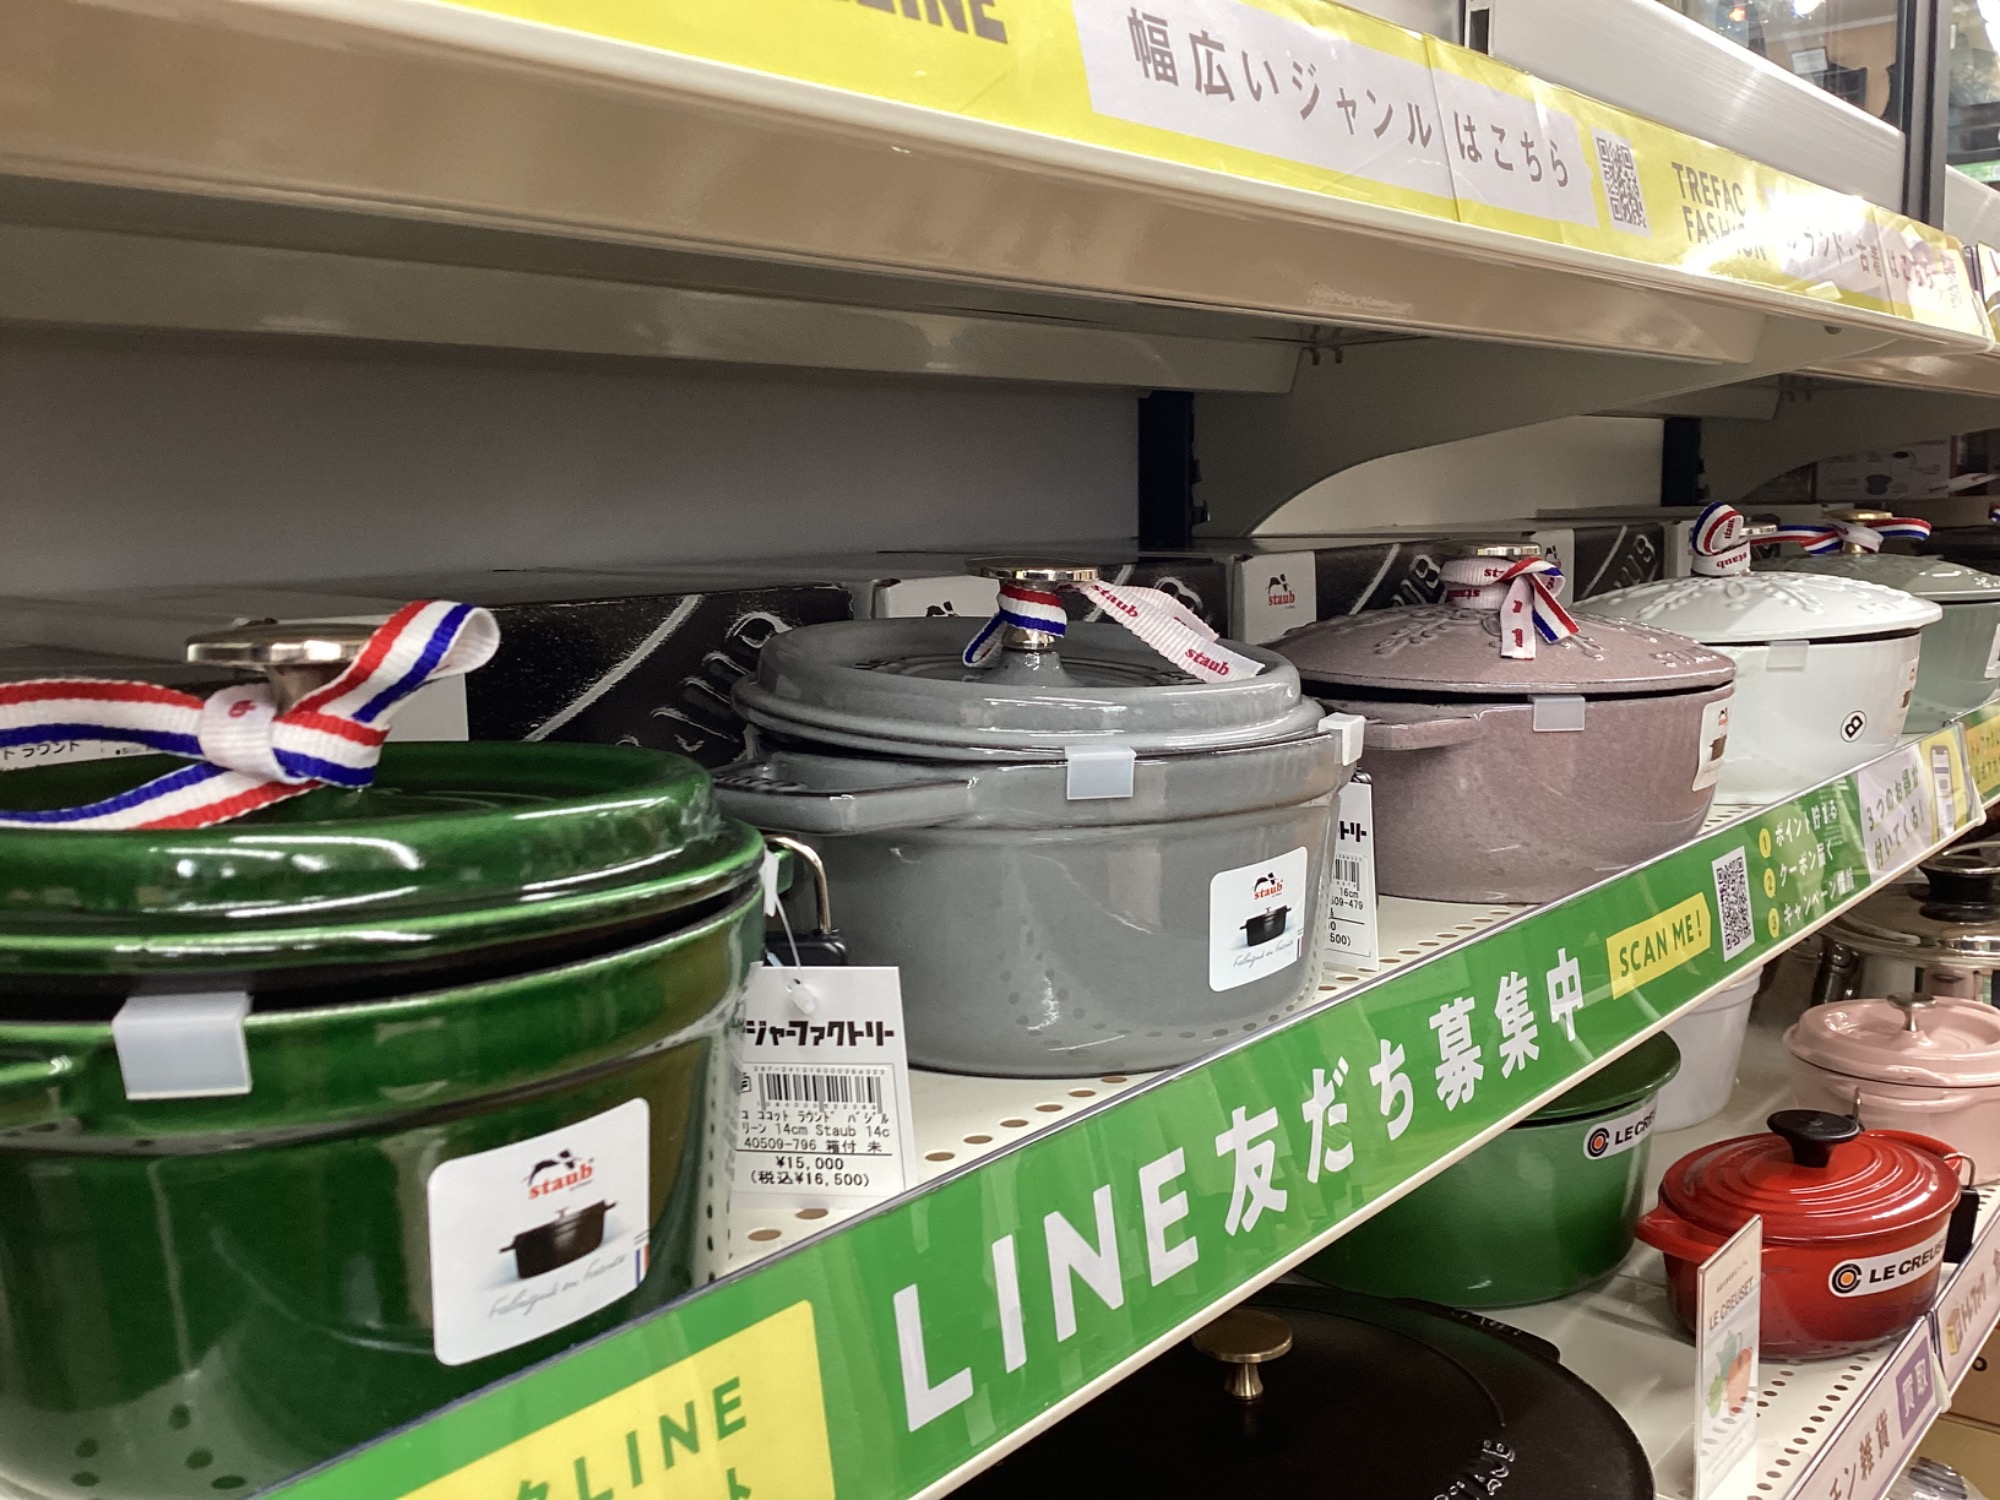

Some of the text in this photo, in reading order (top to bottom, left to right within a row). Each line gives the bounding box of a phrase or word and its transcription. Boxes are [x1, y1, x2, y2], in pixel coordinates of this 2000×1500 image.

[1671, 162, 1747, 217] TREFAC
[1091, 584, 1139, 619] staub
[1267, 592, 1296, 606] staub
[1184, 647, 1231, 677] staub
[1253, 881, 1284, 900] staub
[1339, 886, 1360, 899] 16cm
[1619, 928, 1669, 978] SCAN
[776, 1123, 808, 1136] 14cm
[815, 1124, 856, 1137] Staub
[867, 1125, 890, 1138] 14c
[1615, 1125, 1634, 1146] LE
[744, 1137, 817, 1151] 40509-796
[776, 1156, 844, 1171] ¥15,000
[528, 1163, 594, 1200] staub
[1869, 1264, 1897, 1284] LE
